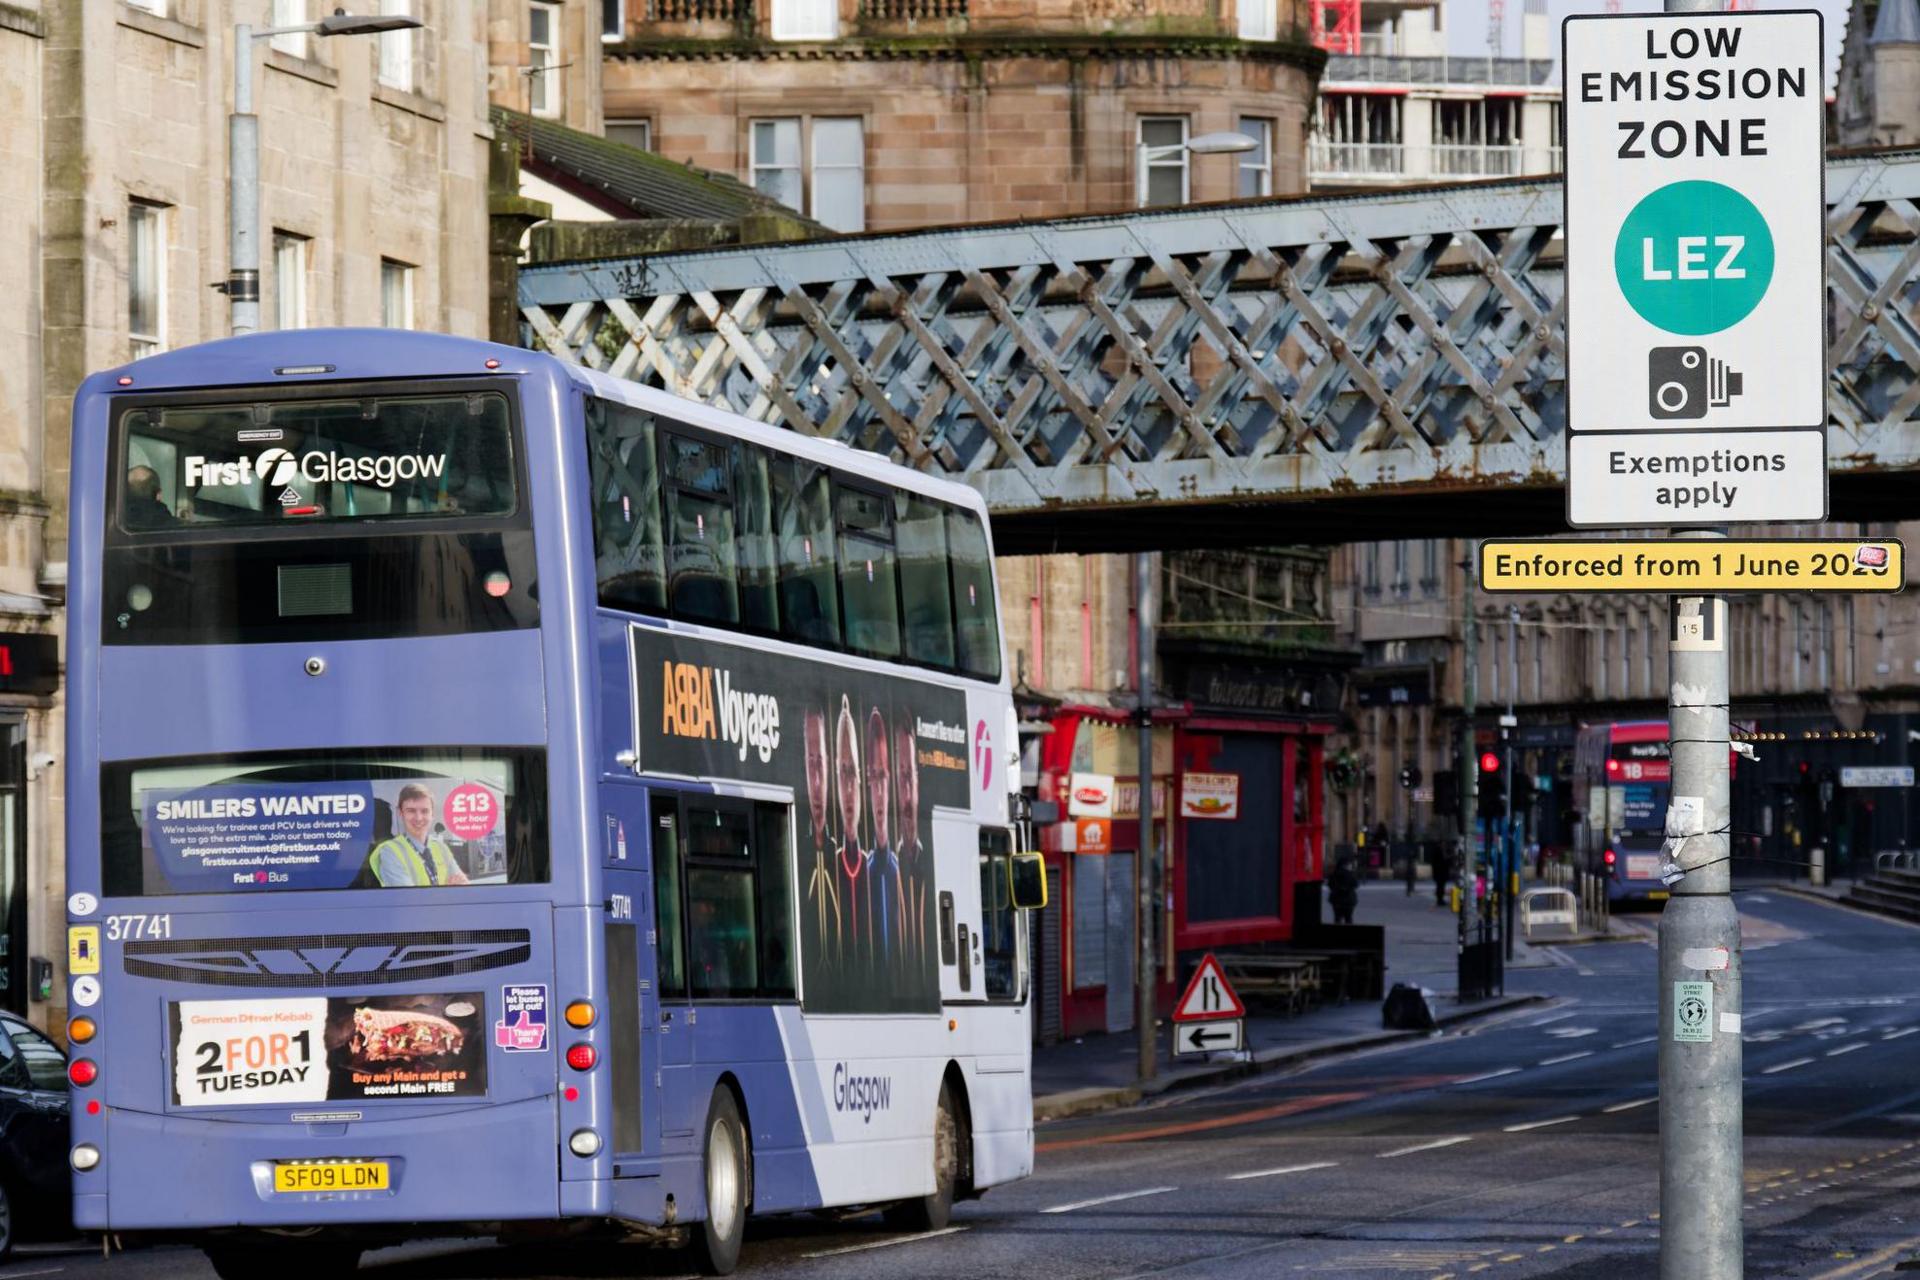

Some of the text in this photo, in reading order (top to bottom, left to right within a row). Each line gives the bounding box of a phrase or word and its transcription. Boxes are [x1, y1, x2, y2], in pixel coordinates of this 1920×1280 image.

[1647, 27, 1742, 59] LOW
[1581, 67, 1805, 102] EMISSION
[1618, 118, 1768, 159] ZONE
[1643, 235, 1746, 280] LEZ
[184, 450, 447, 488] First Glasgow
[1609, 450, 1786, 477] Exemptions
[1655, 481, 1738, 508] apply
[1496, 554, 1623, 577] Enforced
[1634, 554, 1700, 576] from
[1712, 554, 1722, 576] 1
[1734, 554, 1801, 577] June
[663, 660, 780, 763] ABBA Voyage
[1623, 763, 1643, 779] 18
[156, 794, 366, 820] SMILERS WANTED
[452, 792, 490, 813] £13
[162, 819, 360, 834] We're looking for trainee and PCV bus drivers who
[453, 814, 489, 824] per hour
[170, 836, 186, 844] love
[187, 836, 197, 844] to
[198, 836, 208, 845] go
[225, 834, 247, 842] extra
[269, 833, 286, 841] Join
[303, 831, 325, 840] team
[326, 830, 352, 840] today.
[181, 841, 341, 857] glasgowrecruitment@firstbus.co.uk
[202, 854, 320, 867] firstbus.co.uk/recruitment
[233, 872, 289, 883] First Bus
[79, 897, 87, 911] 5
[106, 914, 170, 940] 37741
[506, 995, 544, 1003] let buses
[511, 988, 540, 996] Please
[509, 1003, 524, 1012] pull
[191, 1014, 237, 1024] German
[275, 1011, 313, 1022] Kebab
[514, 1029, 538, 1037] Thank
[518, 1037, 533, 1045] you
[196, 1066, 310, 1094] TUESDAY
[352, 1071, 466, 1084] Buy any Main and get a
[363, 1082, 455, 1095] second Main FREE
[833, 1061, 891, 1124] Glasgow
[284, 1167, 379, 1187] SF09 LDN
